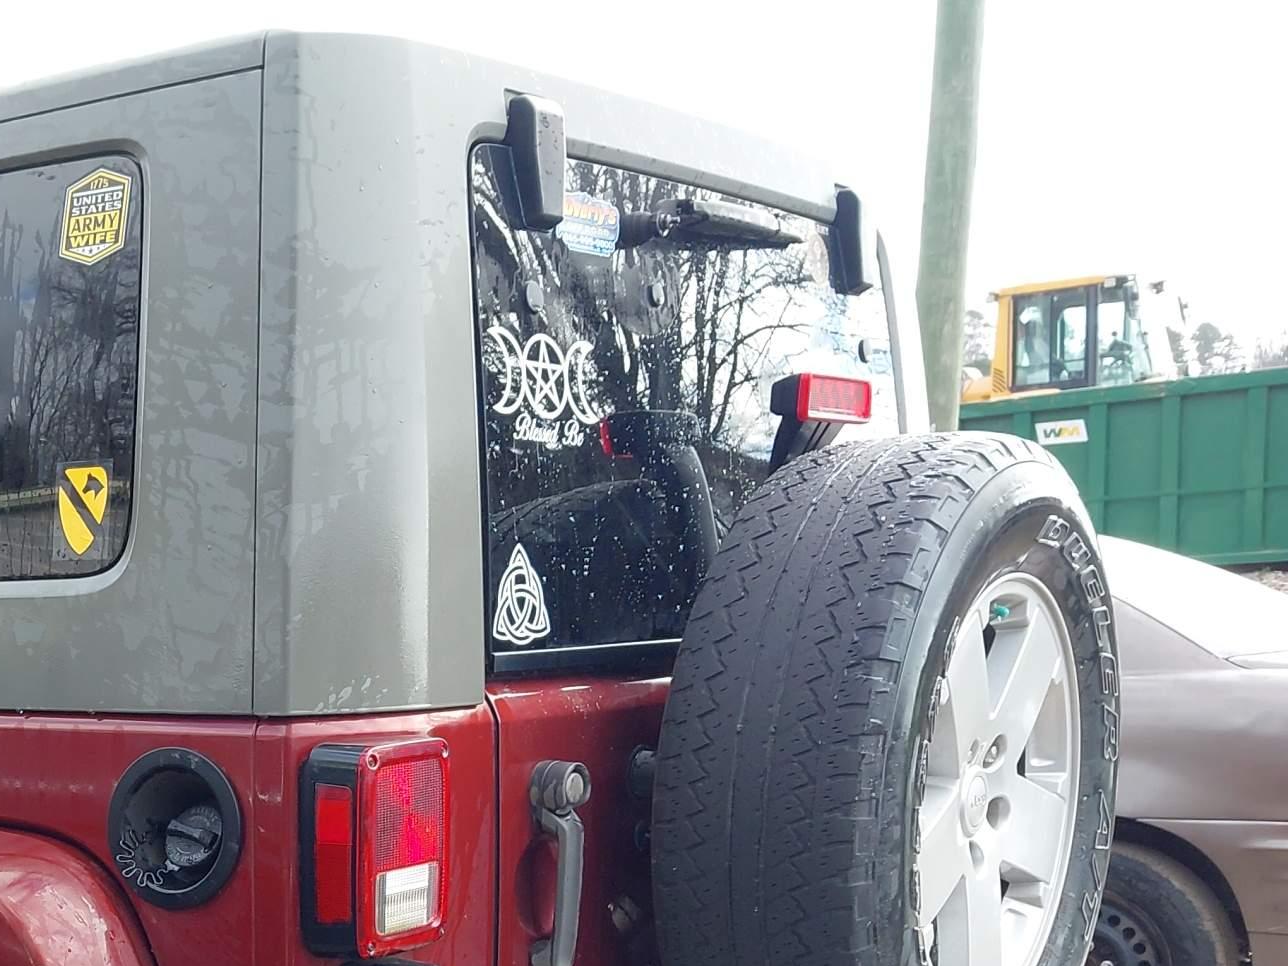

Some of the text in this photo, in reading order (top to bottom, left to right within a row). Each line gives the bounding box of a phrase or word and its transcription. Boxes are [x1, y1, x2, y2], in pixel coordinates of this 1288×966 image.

[90, 178, 109, 190] 1775
[73, 191, 123, 206] UNITED
[72, 200, 122, 216] STATES
[72, 212, 118, 234] ARMY
[70, 230, 116, 248] WIFE
[513, 411, 585, 450] Blessed Be
